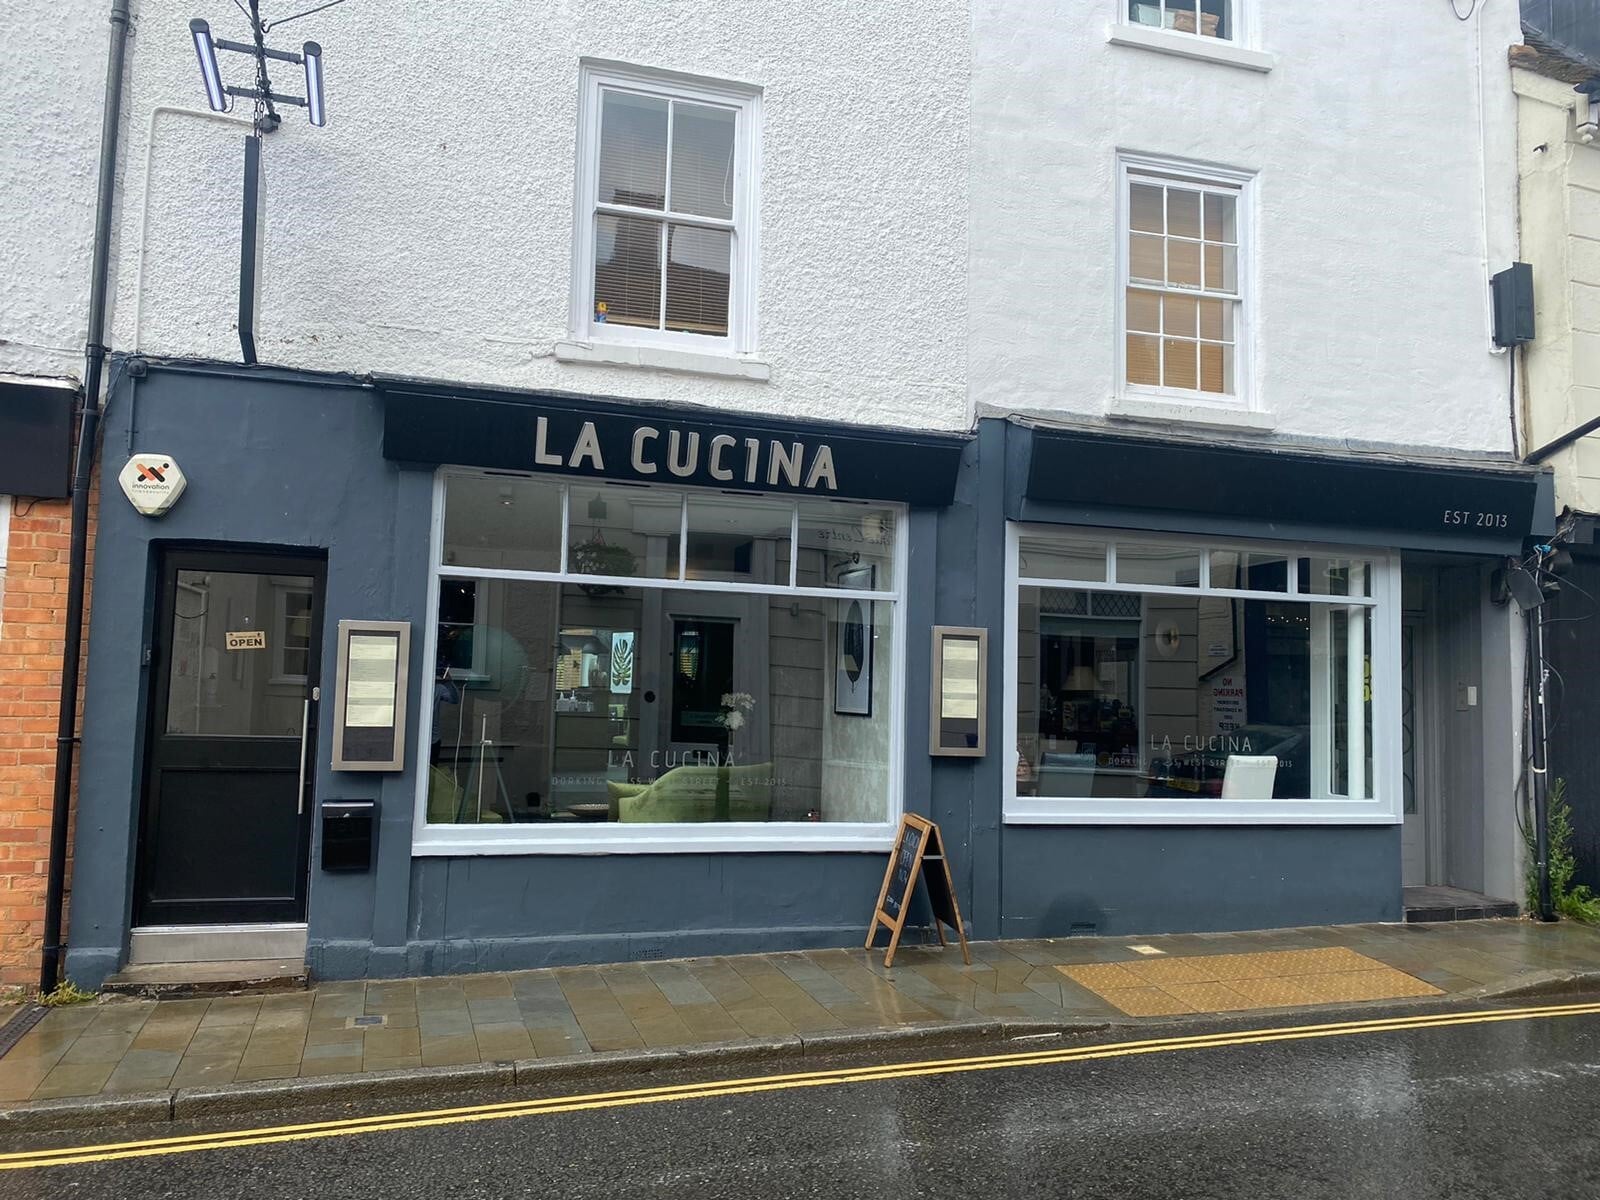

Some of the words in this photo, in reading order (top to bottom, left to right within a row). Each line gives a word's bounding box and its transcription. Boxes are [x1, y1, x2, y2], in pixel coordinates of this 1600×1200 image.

[534, 416, 605, 470] LA
[630, 426, 838, 490] CUCINA
[1444, 510, 1470, 525] EST
[1476, 512, 1508, 528] 2013
[229, 638, 263, 647] OPEN
[1151, 734, 1172, 751] LA
[1183, 735, 1253, 752] CUCINA
[607, 749, 635, 769] LA
[650, 749, 736, 768] CUCINA
